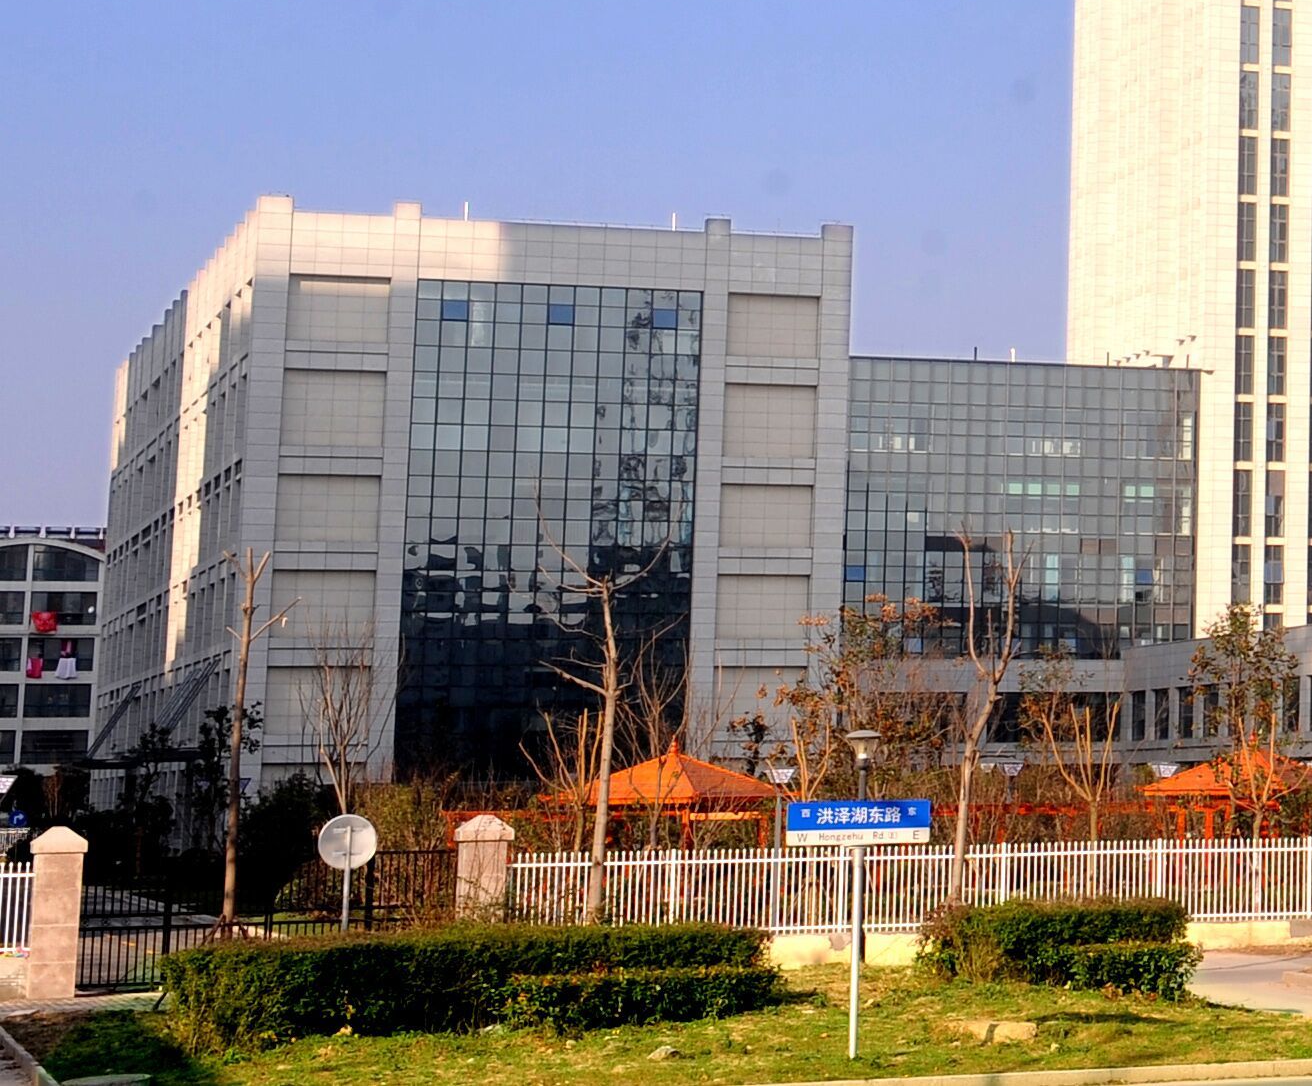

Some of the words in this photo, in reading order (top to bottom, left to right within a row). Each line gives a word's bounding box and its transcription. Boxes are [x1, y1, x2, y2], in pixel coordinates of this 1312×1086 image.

[801, 808, 811, 818] 西
[816, 806, 902, 825] 洪泽湖东路
[907, 806, 917, 817] 东
[796, 833, 808, 843] W
[818, 832, 864, 842] Hongzehu
[872, 831, 884, 840] Rd
[912, 830, 920, 840] E
